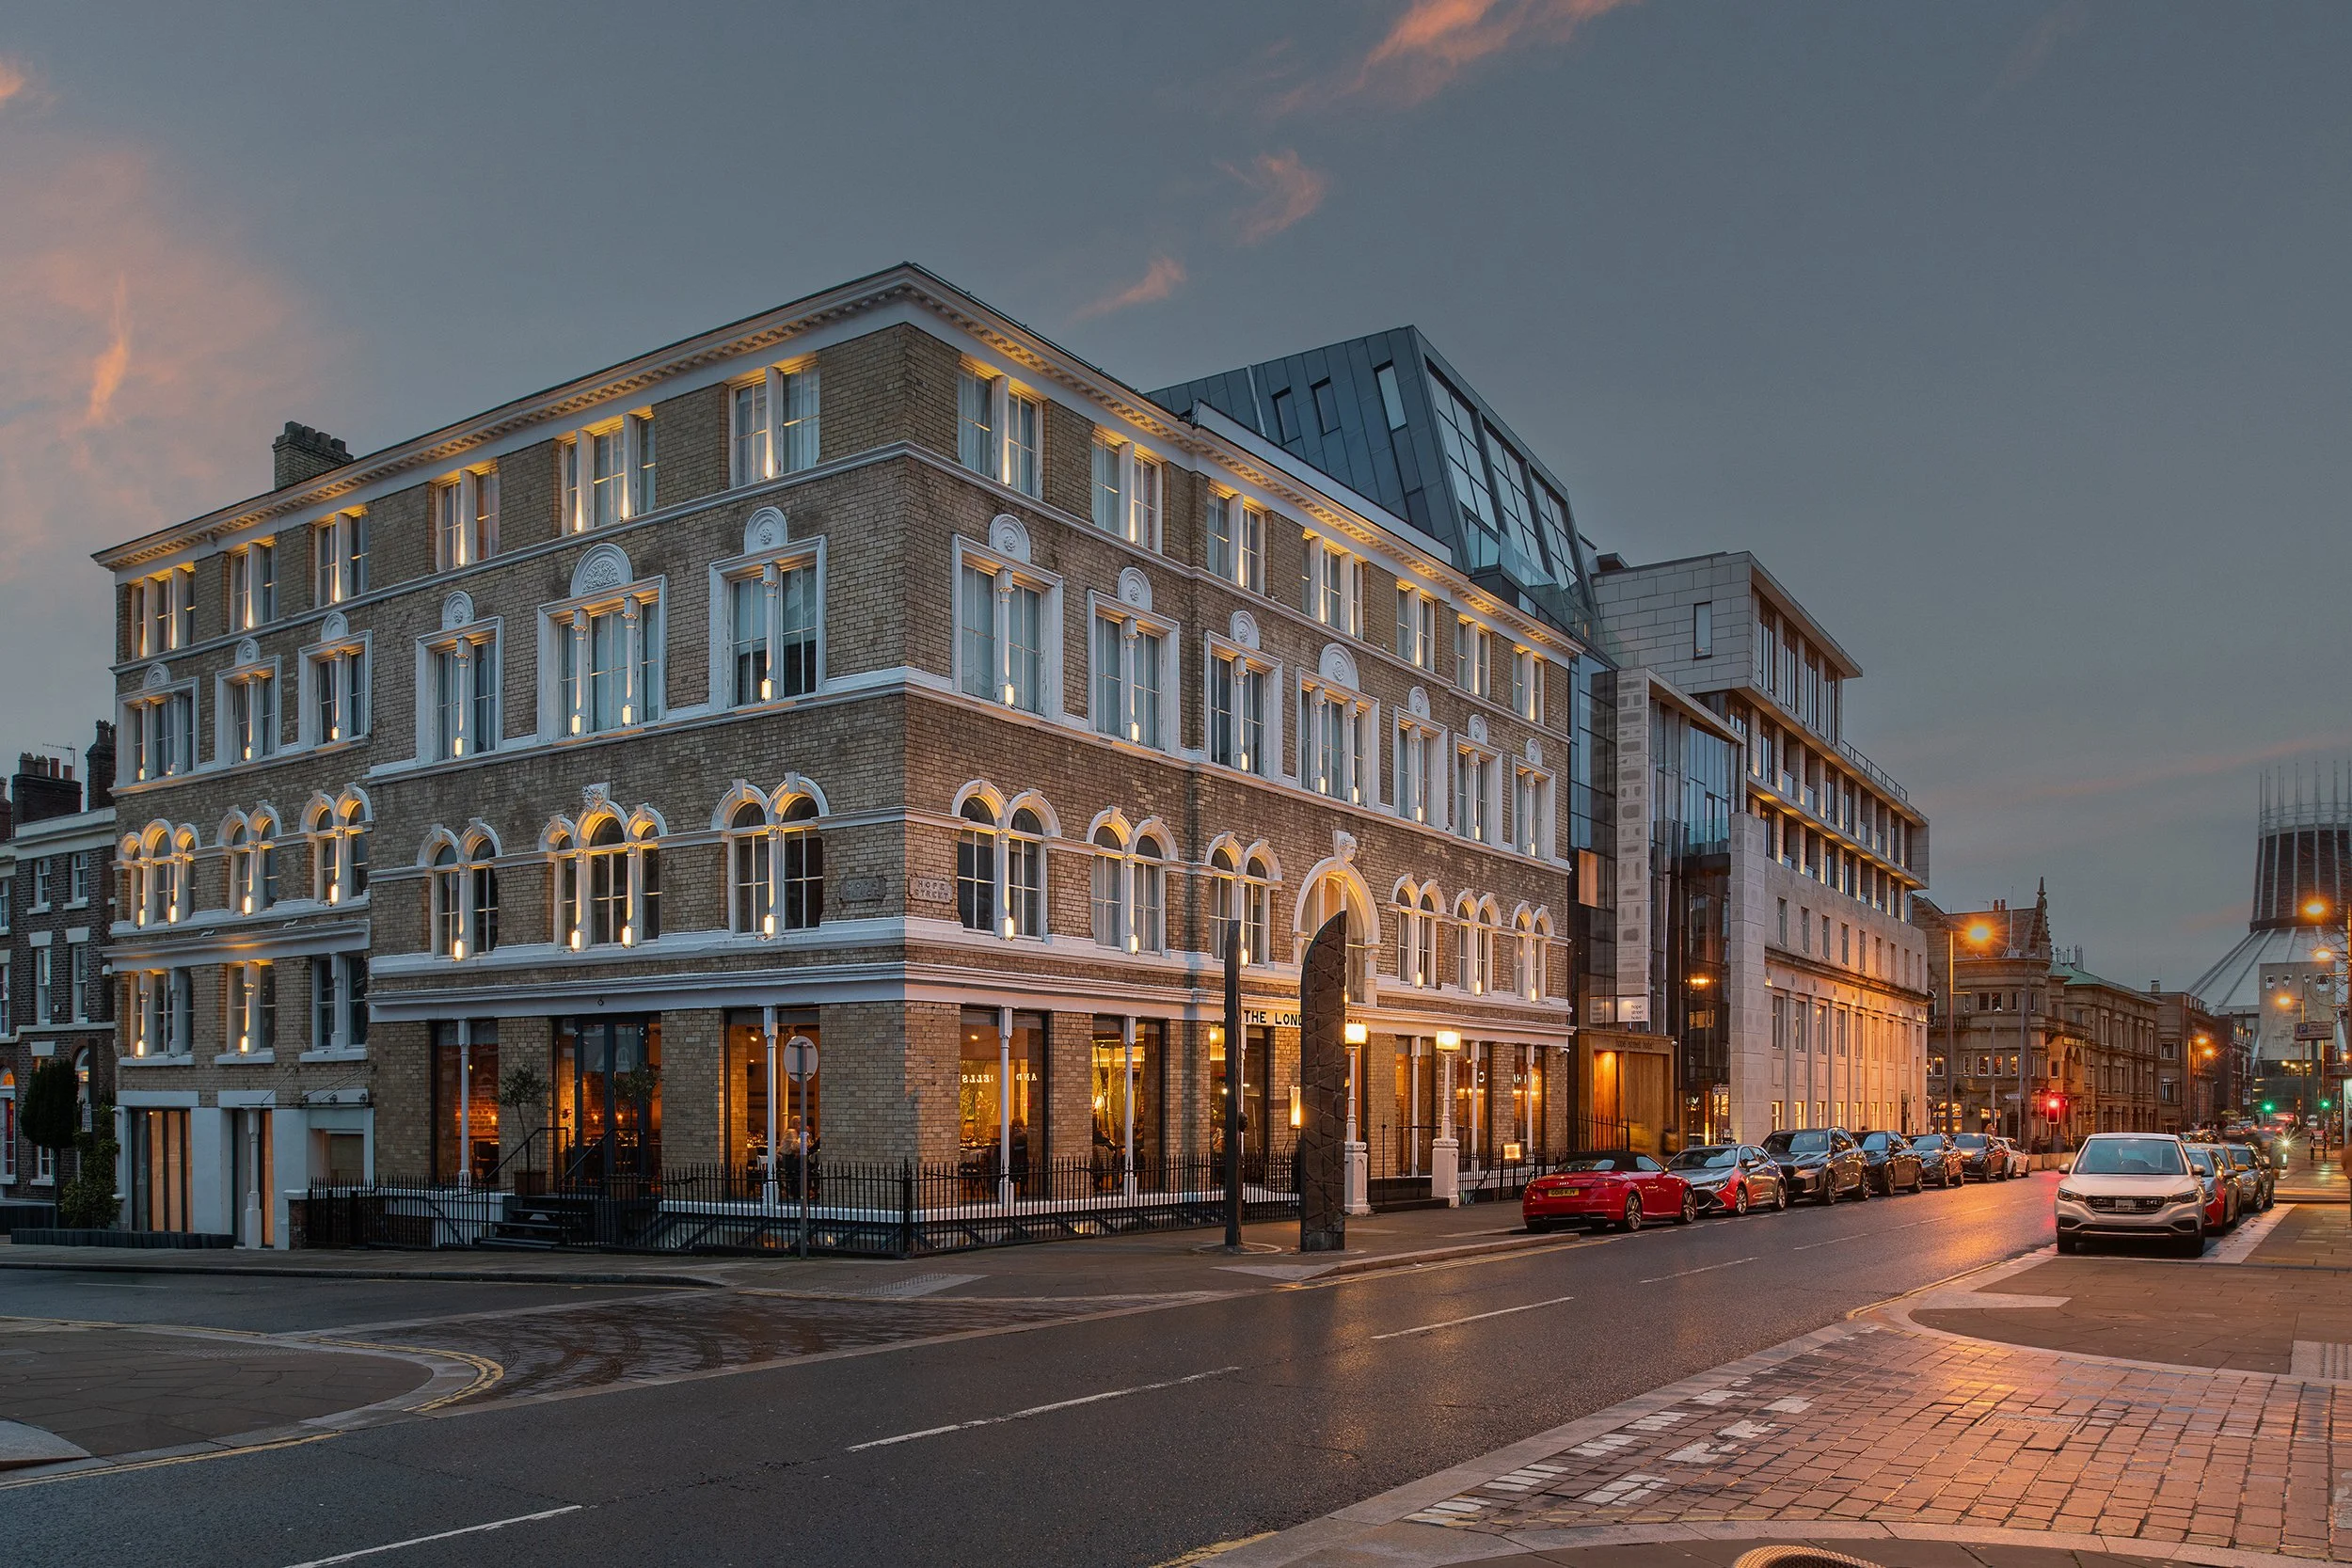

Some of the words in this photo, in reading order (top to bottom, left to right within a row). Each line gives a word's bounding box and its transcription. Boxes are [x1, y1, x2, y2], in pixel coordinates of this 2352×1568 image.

[917, 880, 946, 891] HOPE
[914, 889, 949, 899] STREET
[1244, 1009, 1267, 1023] THE
